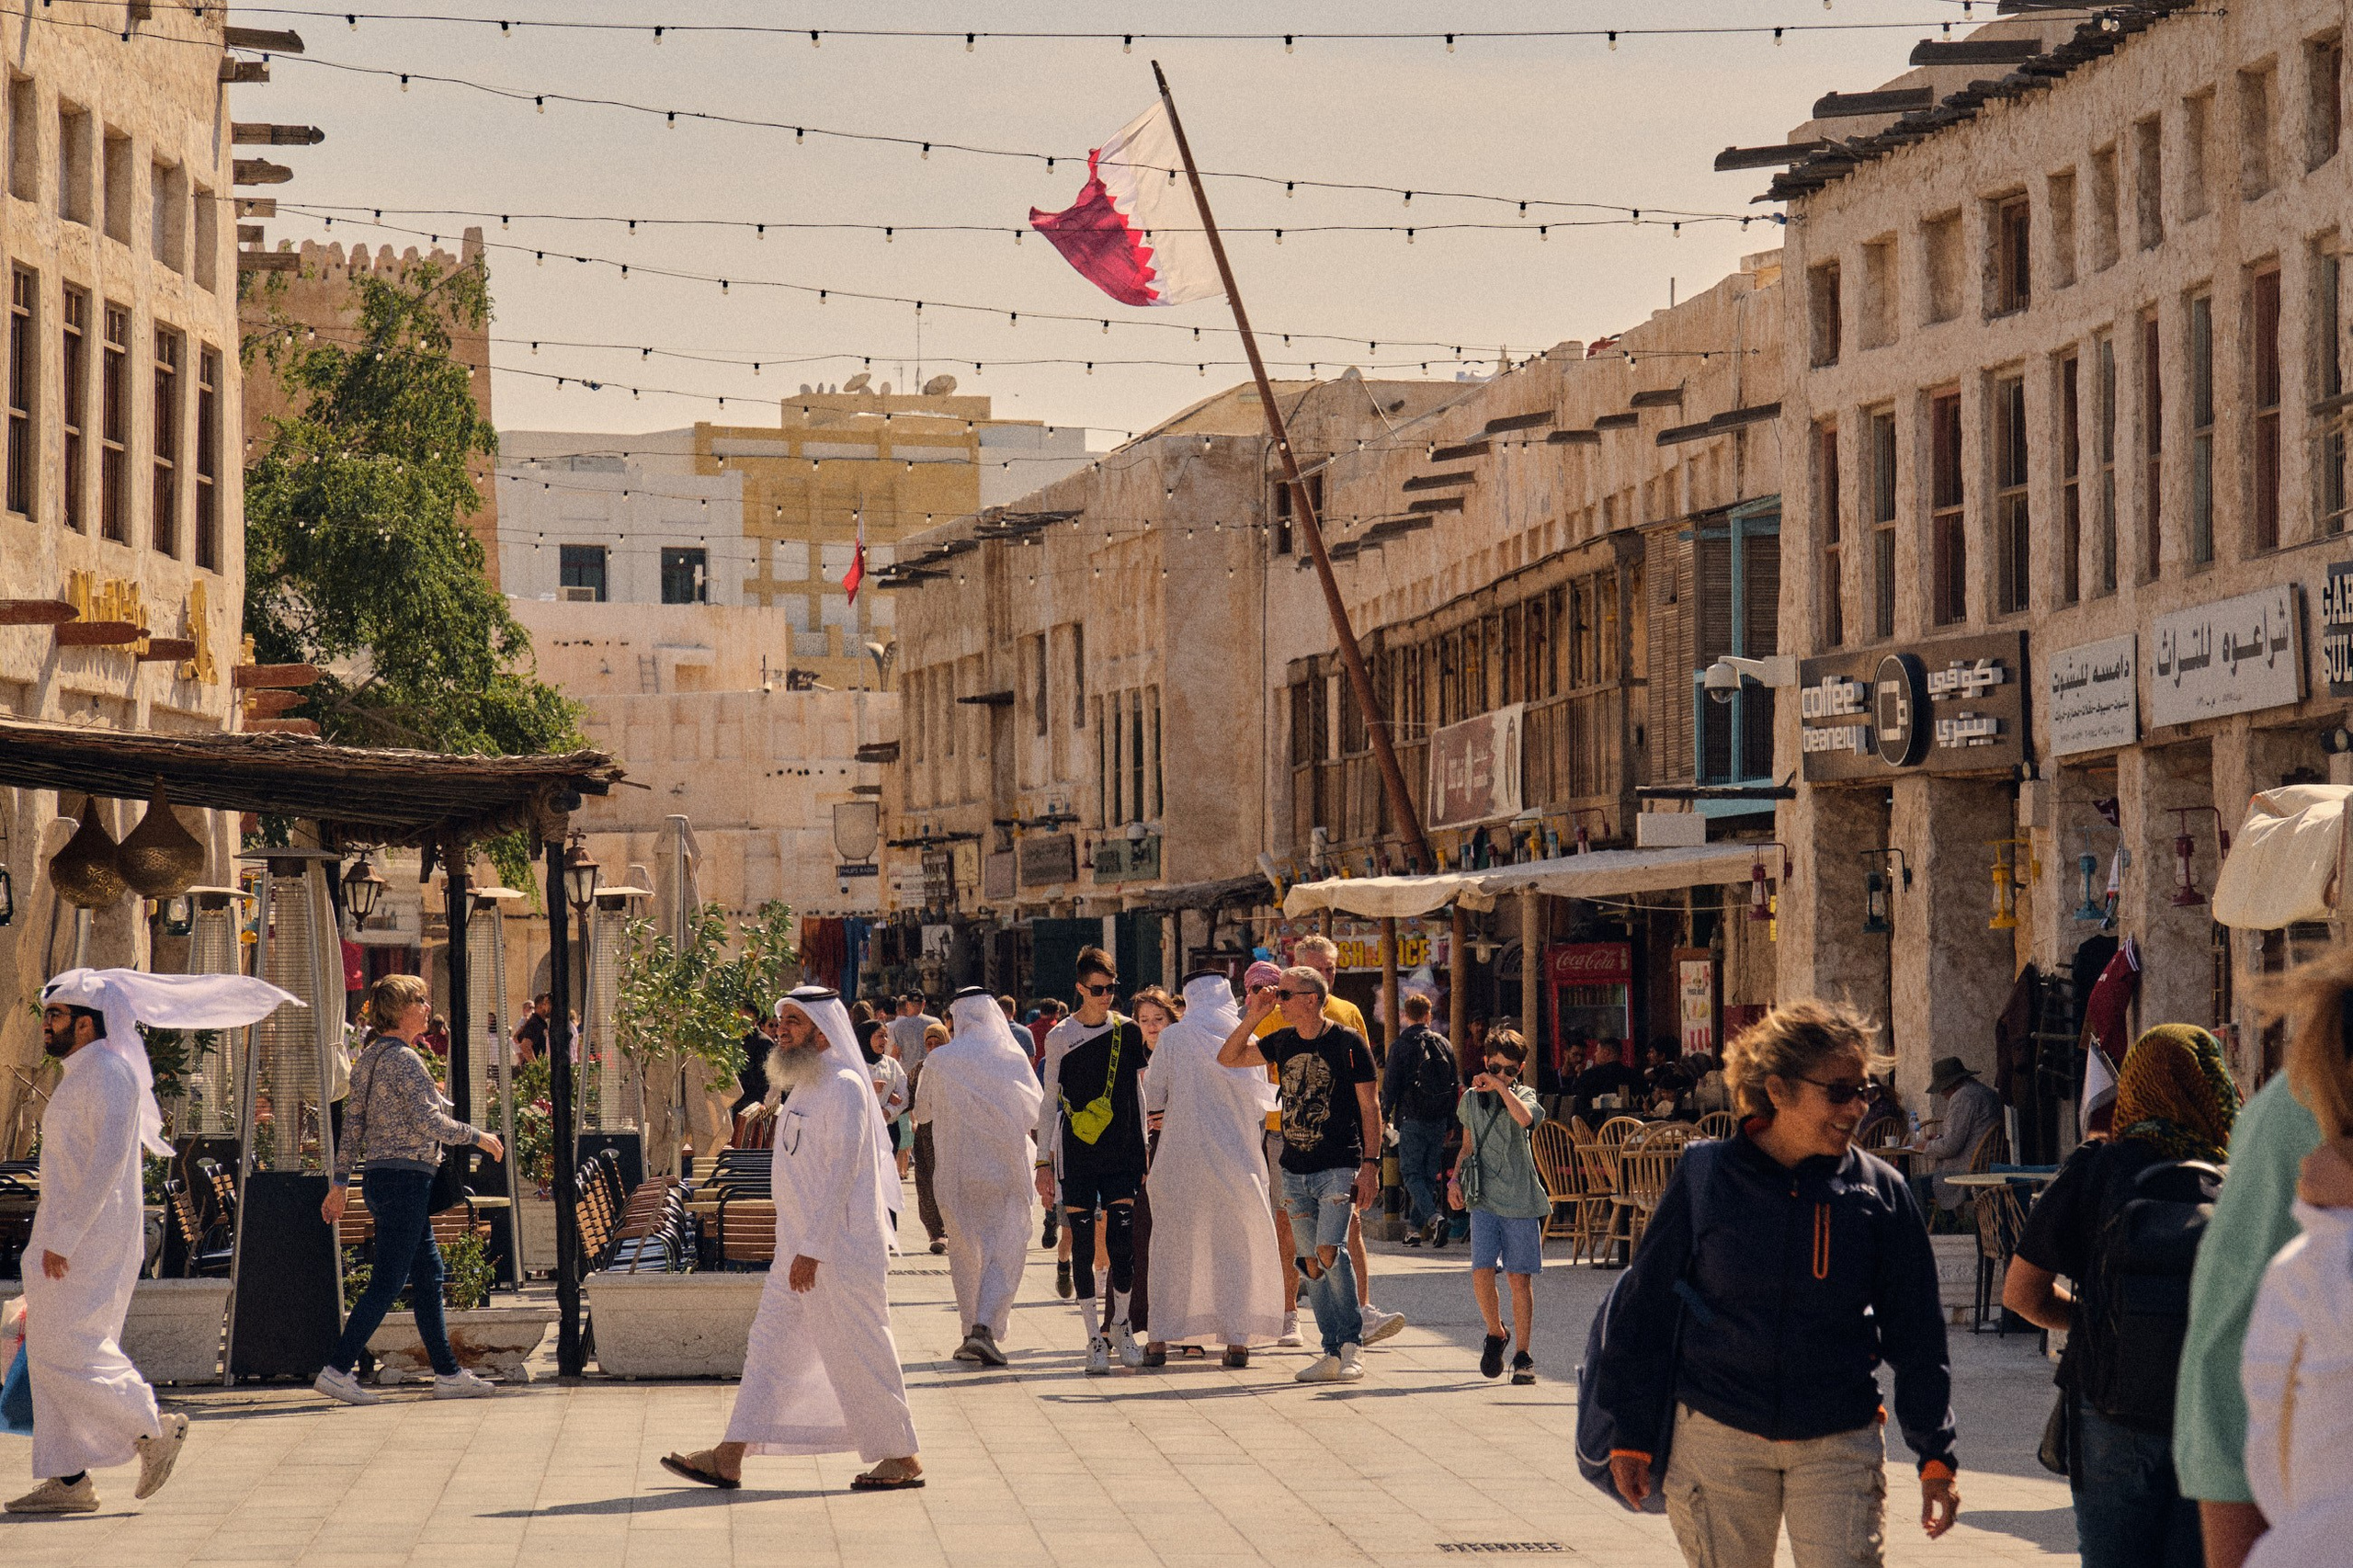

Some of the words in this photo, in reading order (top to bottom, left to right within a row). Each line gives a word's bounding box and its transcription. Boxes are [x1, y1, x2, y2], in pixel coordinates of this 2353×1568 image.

[2157, 621, 2211, 689] للتراث
[2323, 633, 2353, 685] SUL
[1802, 676, 1860, 719] coffee
[1927, 658, 2002, 701] كوفي
[1802, 725, 1862, 756] beanery
